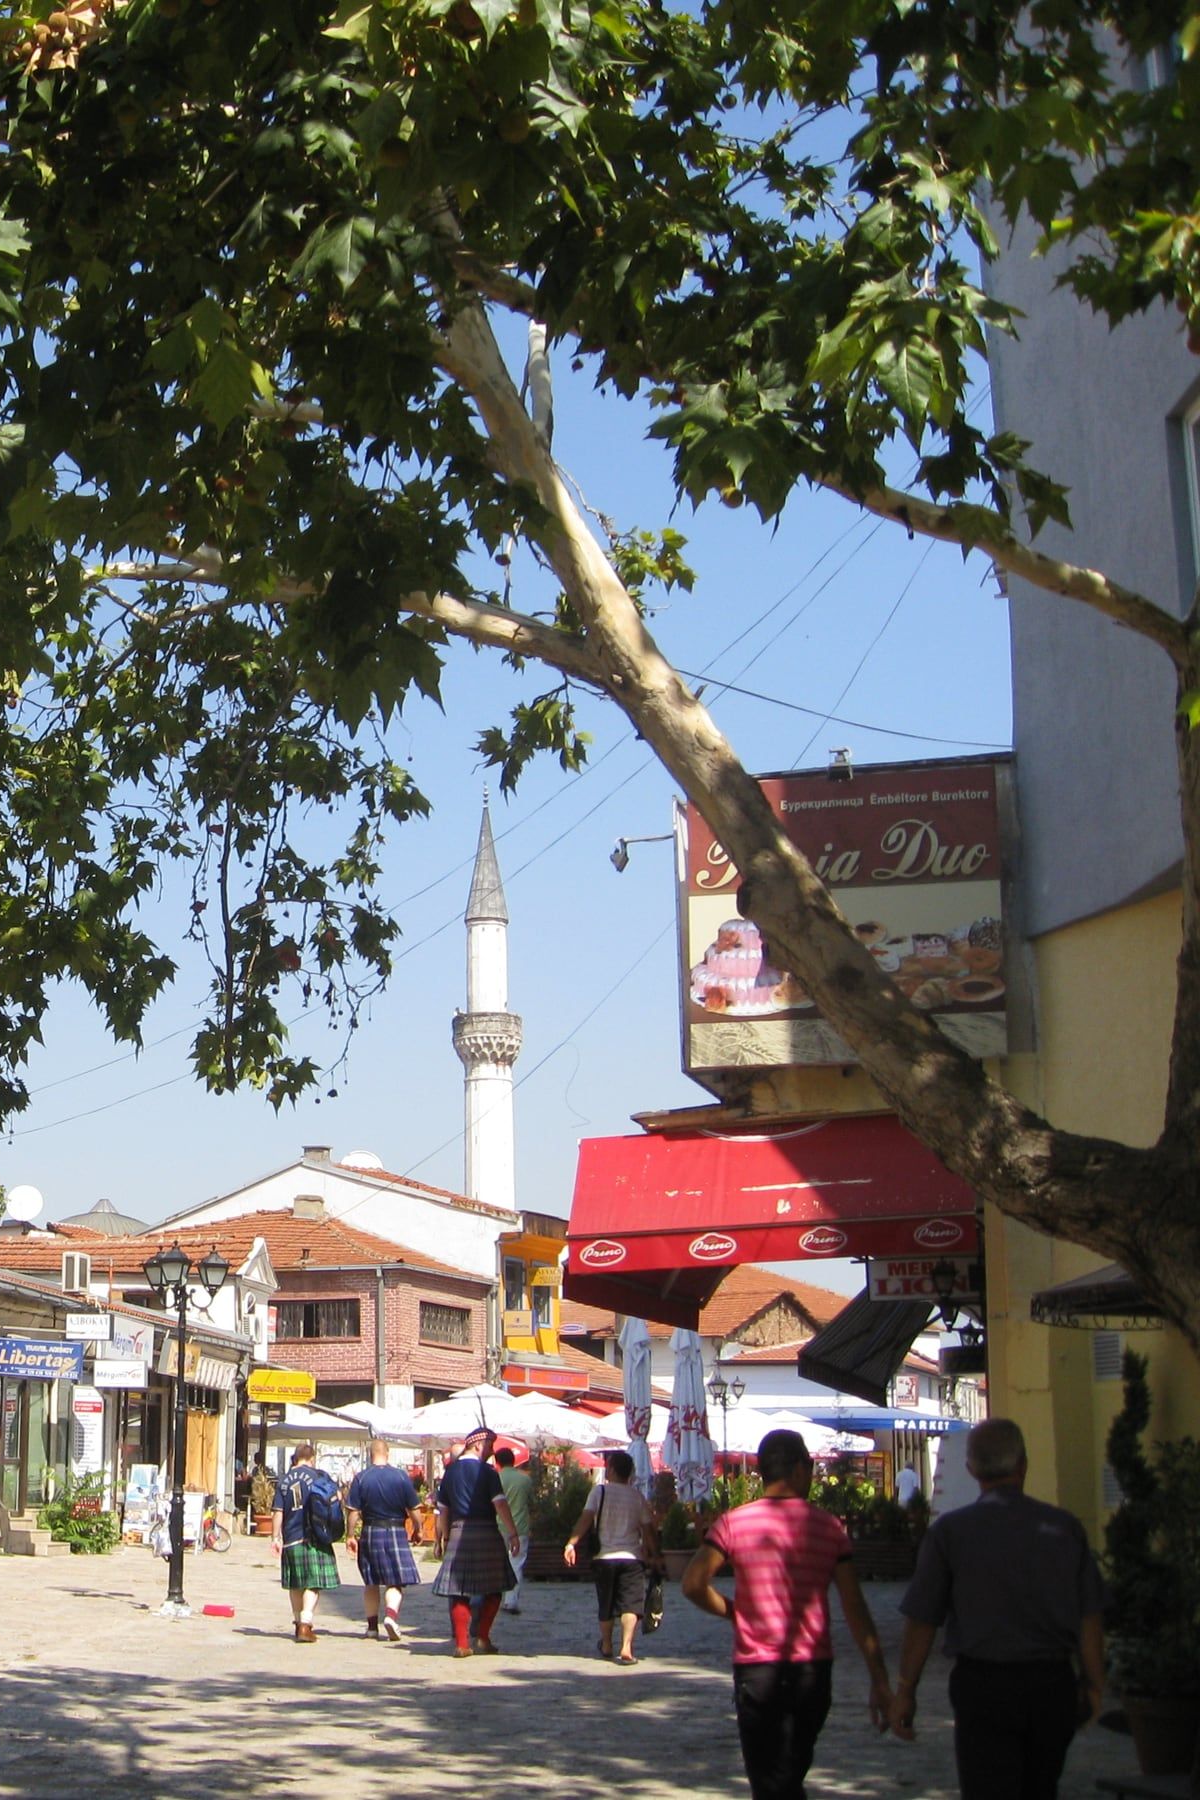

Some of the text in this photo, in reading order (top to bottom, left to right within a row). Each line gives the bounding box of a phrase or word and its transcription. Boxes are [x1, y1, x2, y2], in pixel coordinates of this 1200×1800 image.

[932, 789, 990, 802] Burektore
[871, 818, 991, 880] Duo
[290, 1480, 304, 1511] 1
